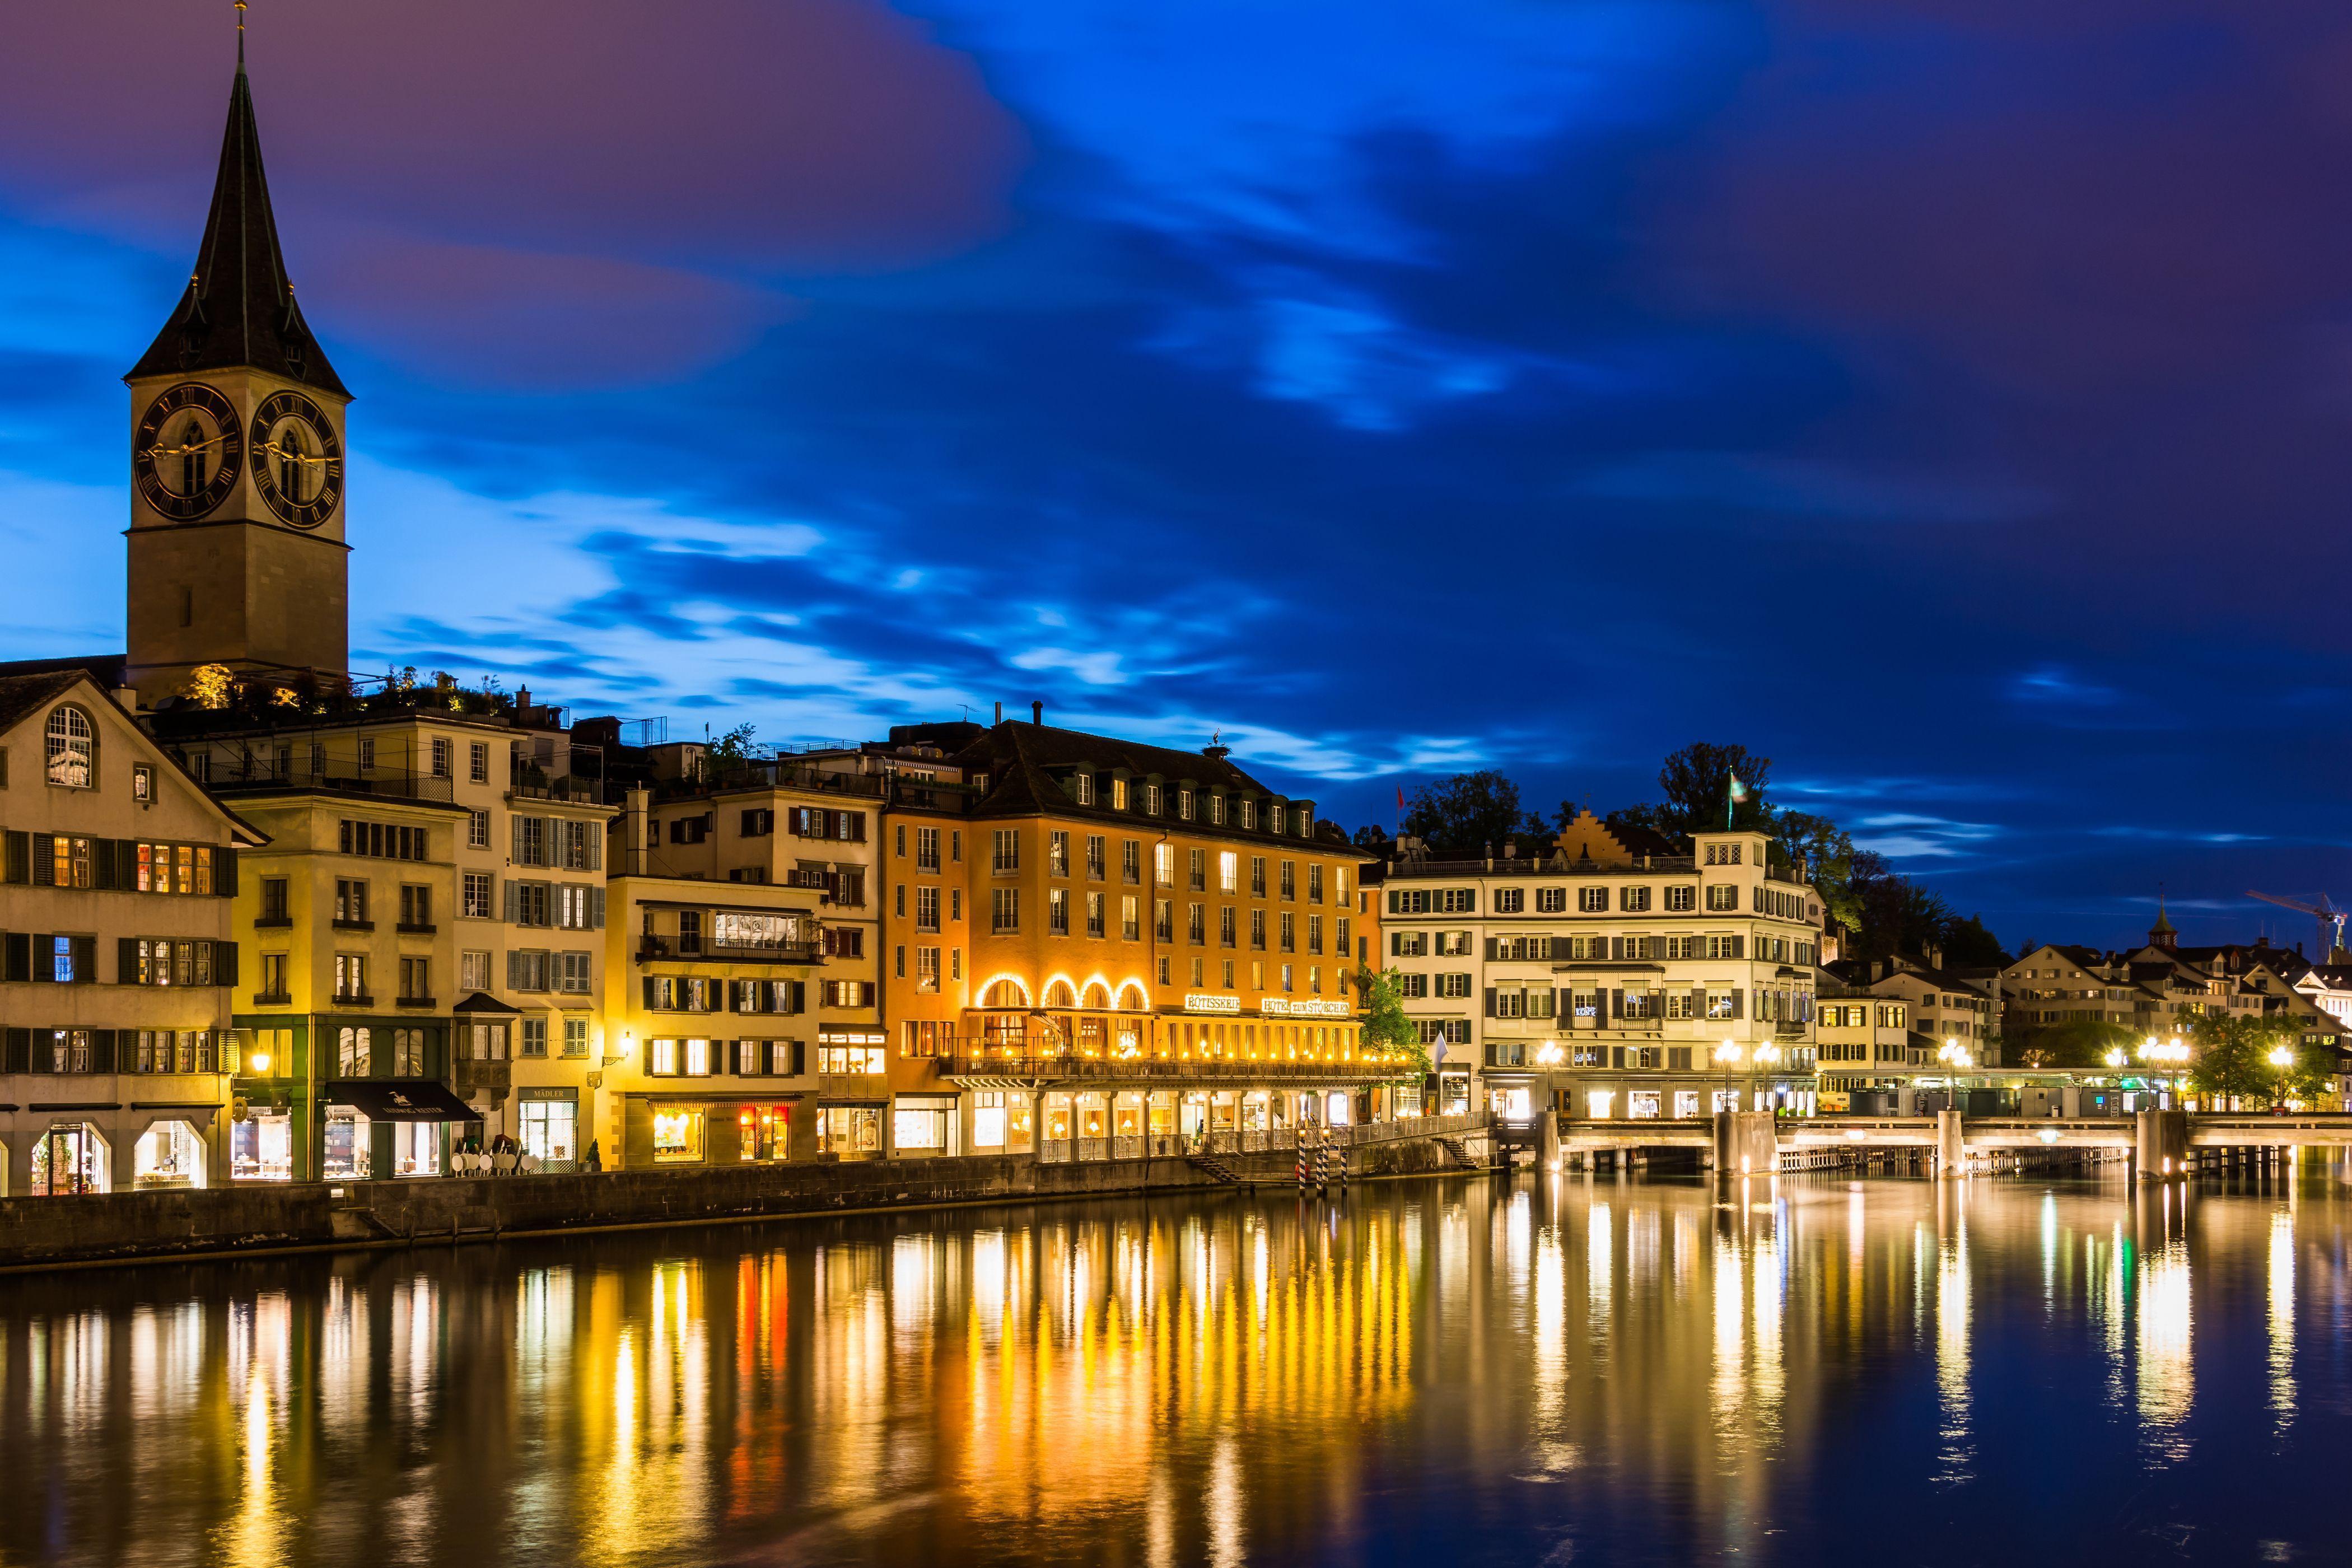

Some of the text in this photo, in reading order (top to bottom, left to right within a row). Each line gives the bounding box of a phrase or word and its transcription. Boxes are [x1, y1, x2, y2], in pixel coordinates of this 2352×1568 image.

[181, 388, 195, 404] XII
[207, 393, 214, 407] I
[159, 397, 172, 414] XI
[272, 398, 284, 415] XI
[291, 396, 303, 414] XII
[221, 412, 233, 427] II
[258, 415, 269, 430] X
[314, 412, 319, 425] I
[143, 422, 156, 433] X
[226, 440, 238, 454] III
[324, 436, 335, 447] II
[329, 465, 339, 478] III
[1264, 1000, 1290, 1011] HOTEL
[1308, 1002, 1350, 1013] STORCHEN
